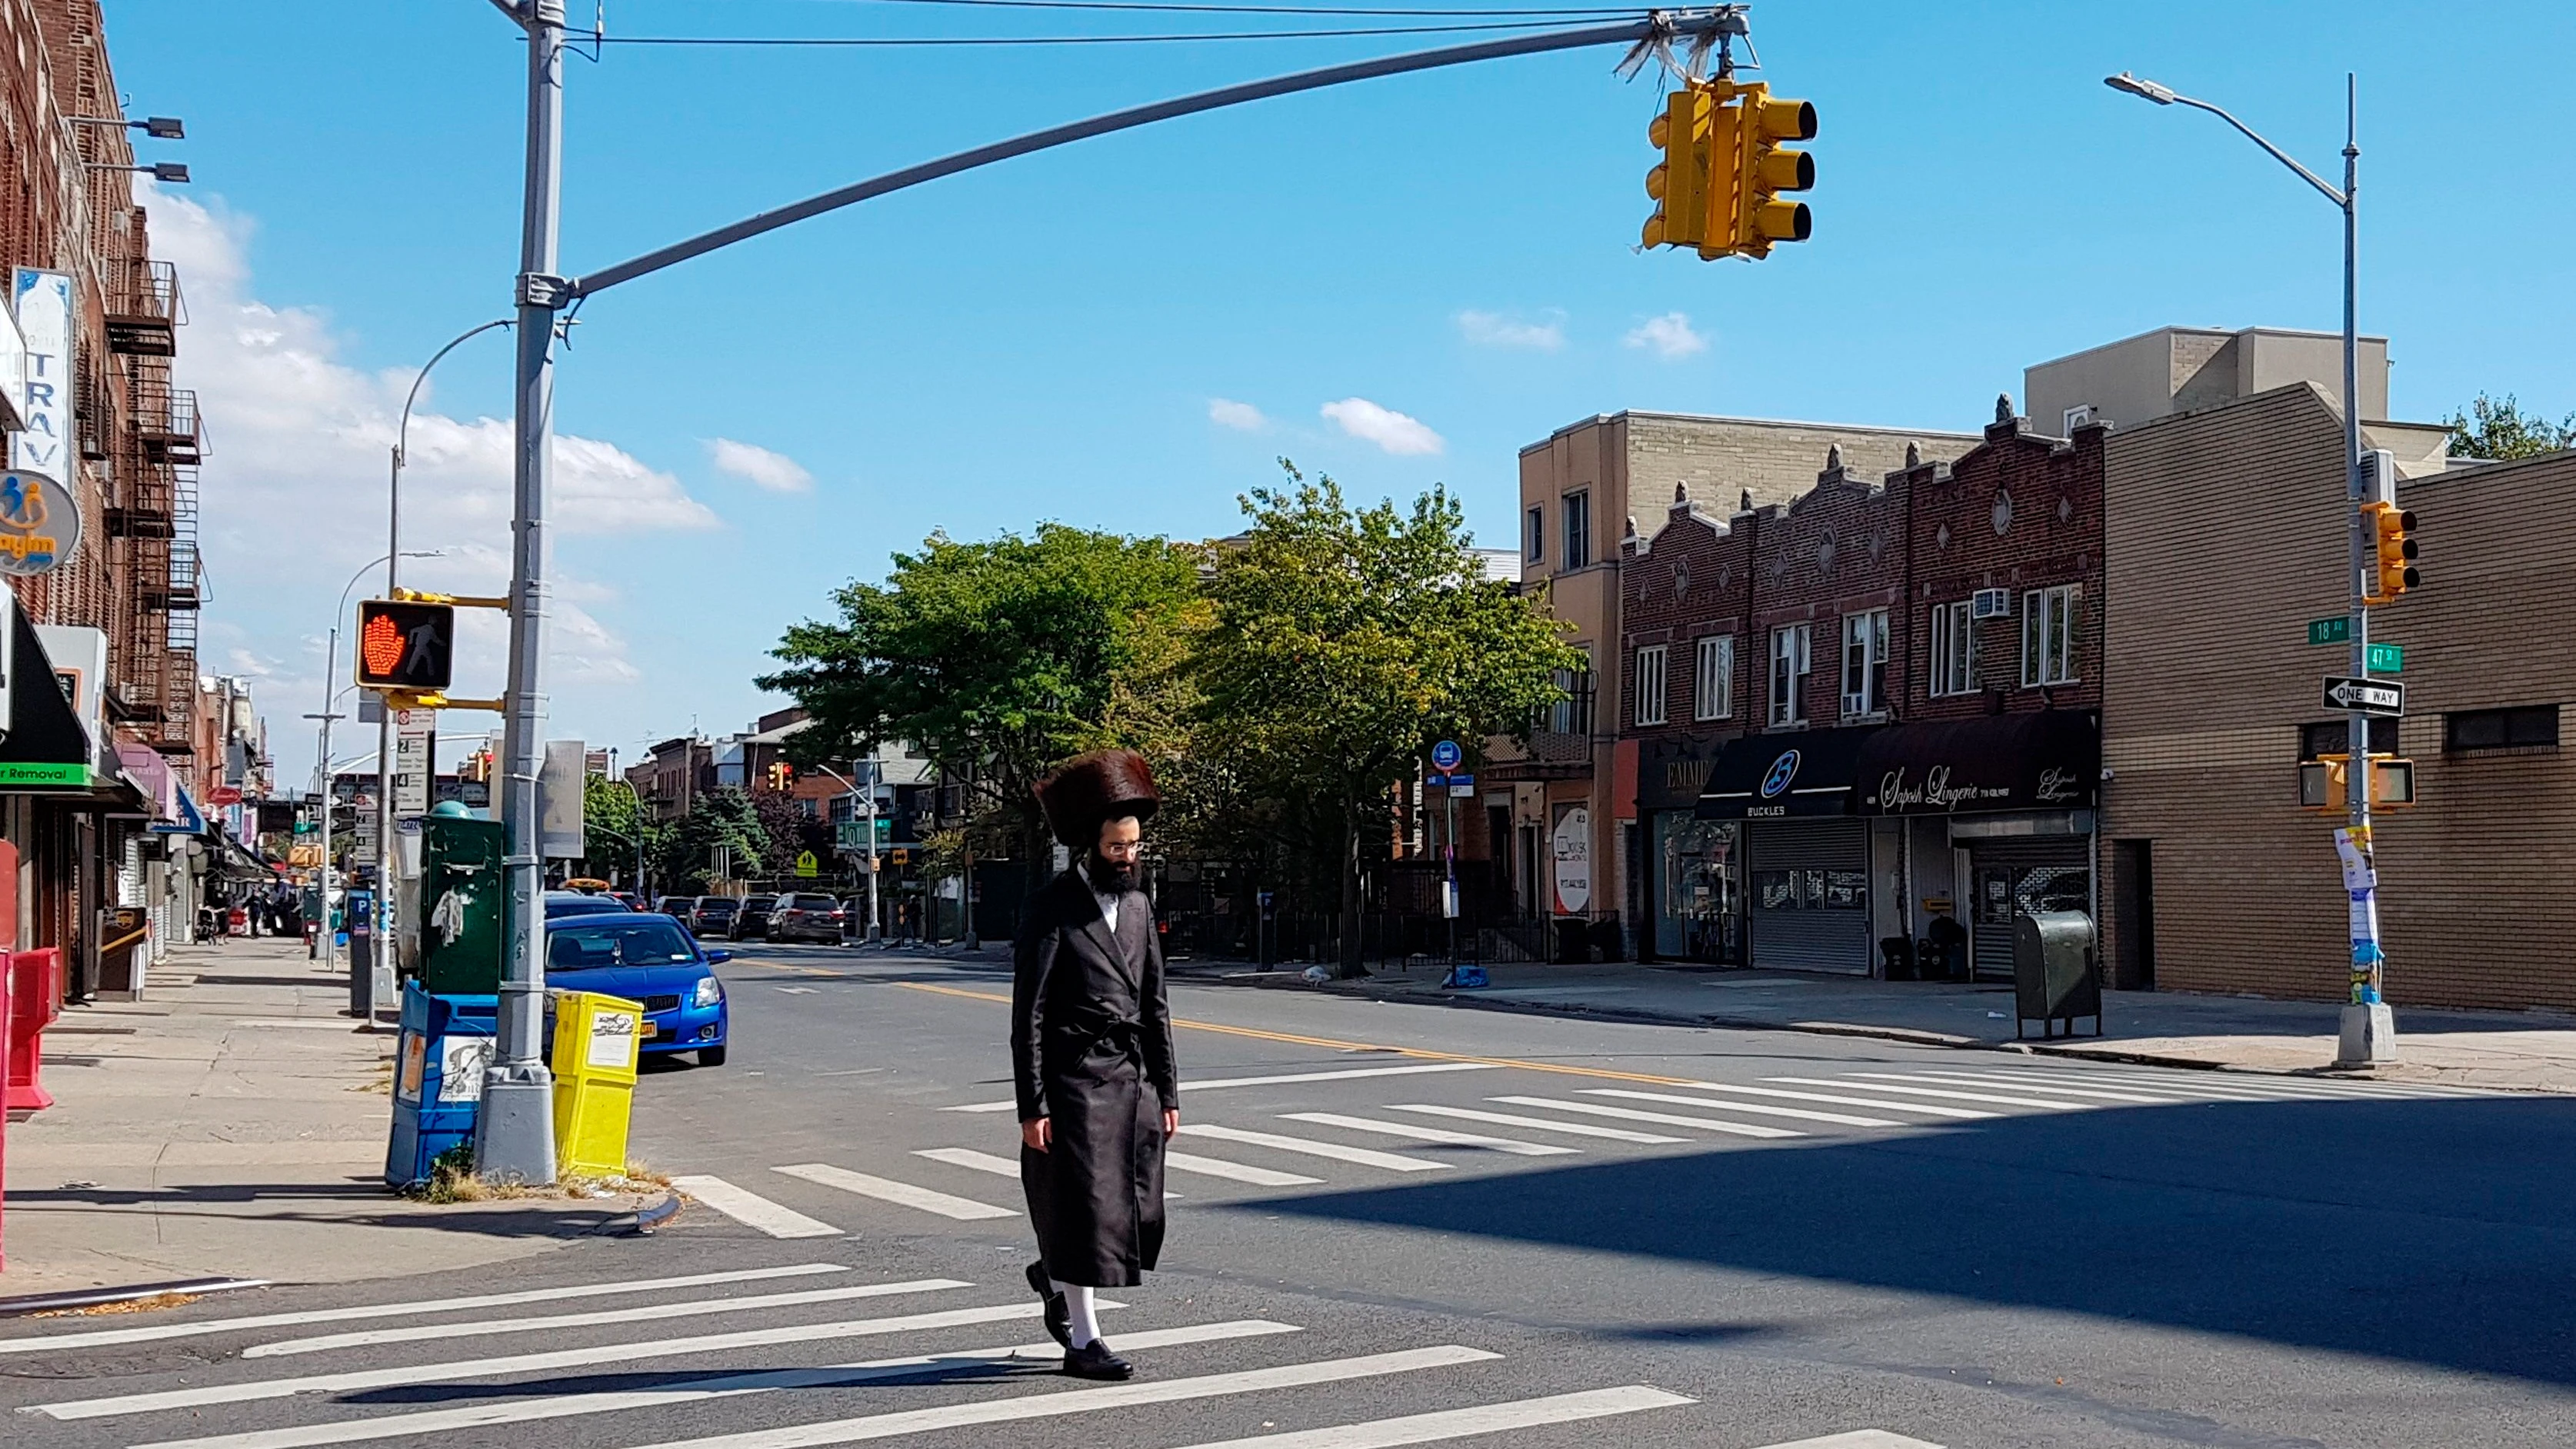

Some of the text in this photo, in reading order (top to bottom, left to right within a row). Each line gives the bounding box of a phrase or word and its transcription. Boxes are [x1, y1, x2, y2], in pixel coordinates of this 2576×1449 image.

[2318, 622, 2329, 640] 18
[2372, 648, 2384, 667] 47
[2338, 687, 2394, 704] ONE WAY
[399, 741, 407, 753] 2
[9, 768, 66, 779] Removal
[399, 774, 406, 787] 4
[1925, 765, 1978, 812] Lingerie
[1748, 806, 1785, 817] BUCKLES
[358, 900, 367, 912] P
